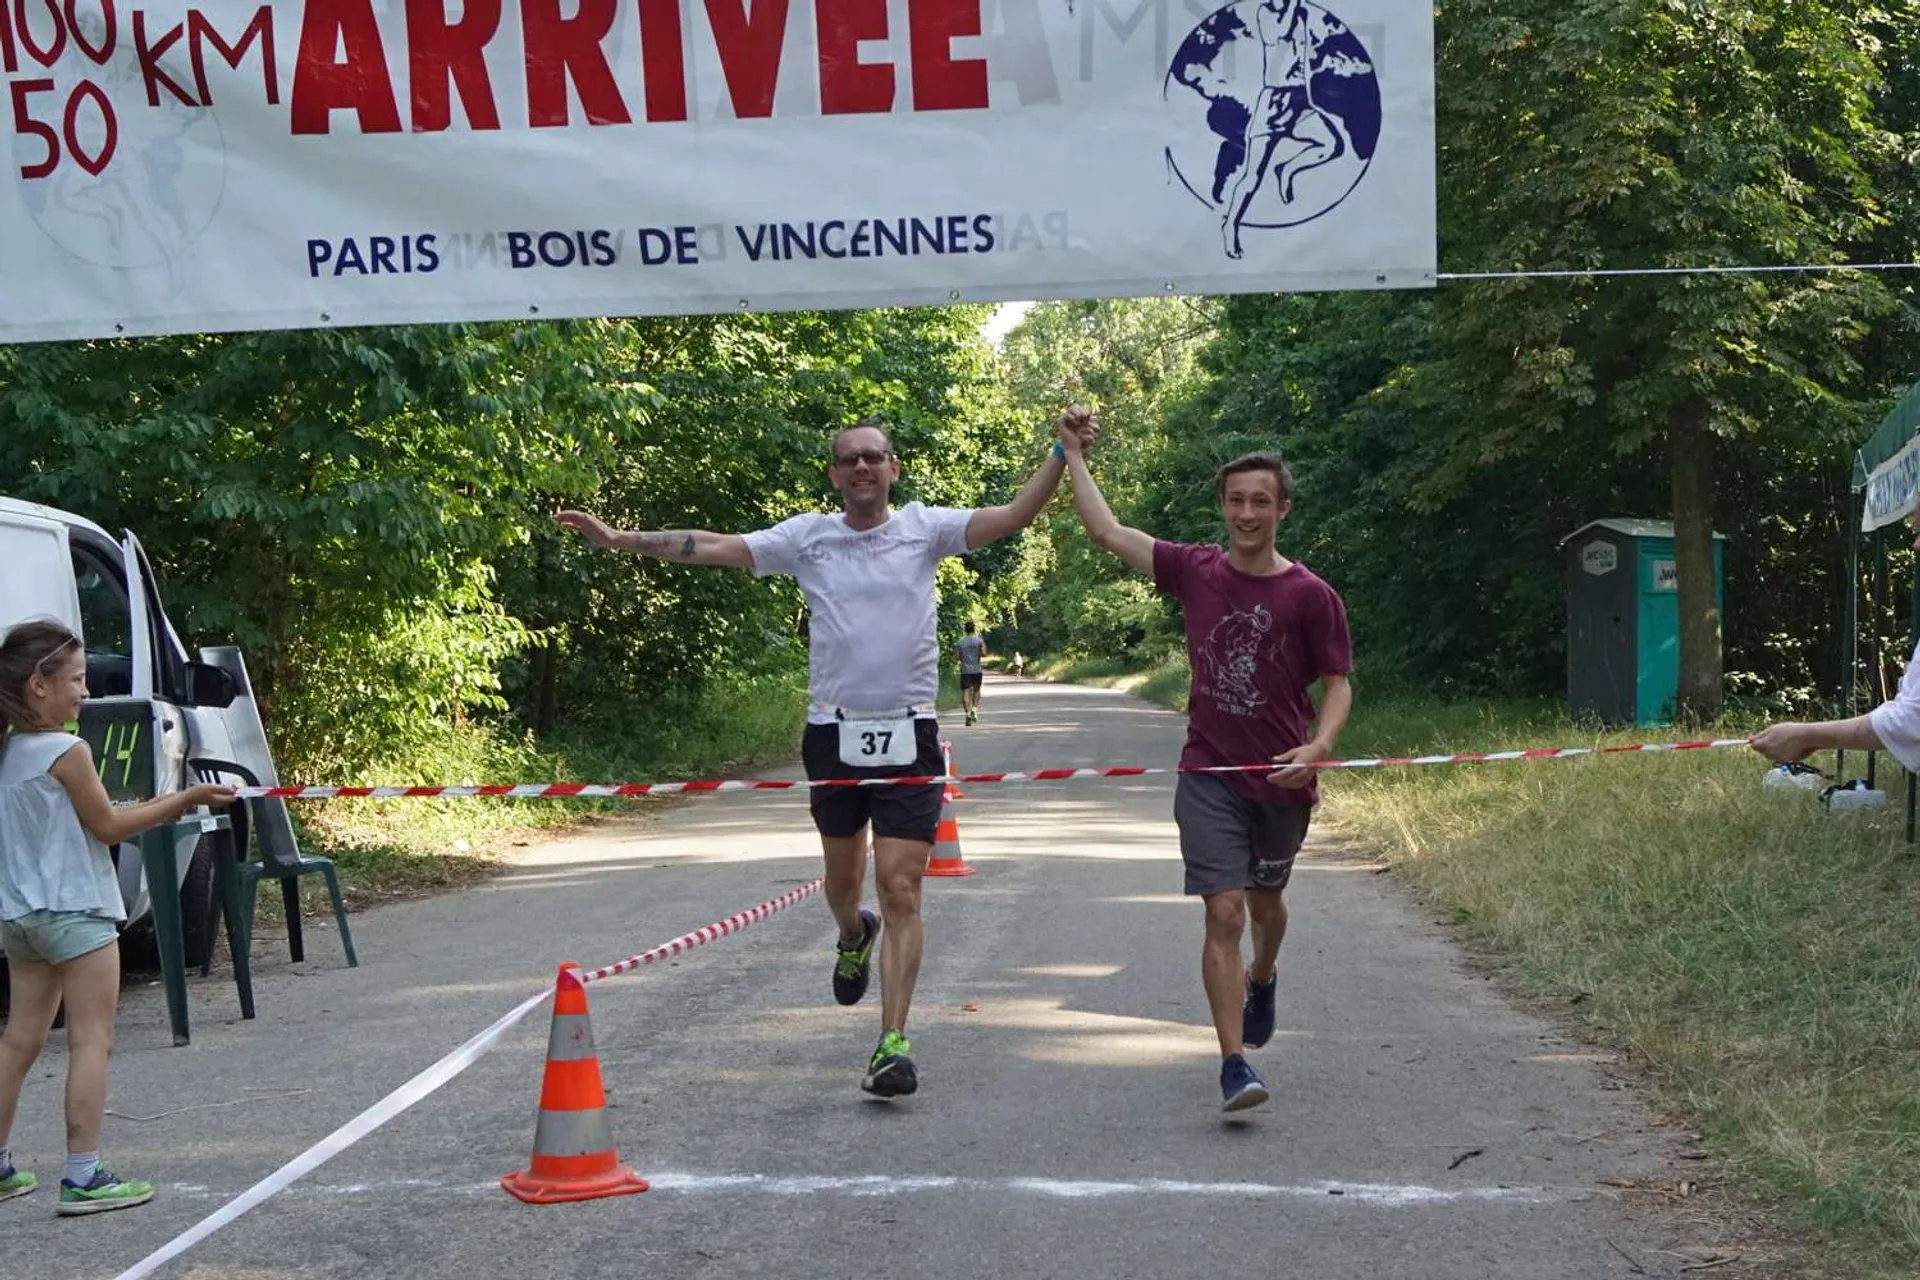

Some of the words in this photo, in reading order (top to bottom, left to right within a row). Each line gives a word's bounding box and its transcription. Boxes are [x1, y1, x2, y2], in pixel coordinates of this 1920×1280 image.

[133, 5, 280, 107] KM
[10, 79, 117, 179] 50
[307, 234, 440, 278] PARIS
[509, 229, 617, 269] BOIS
[639, 226, 699, 266] DE
[735, 214, 996, 262] VINCENNES
[860, 731, 893, 756] 37
